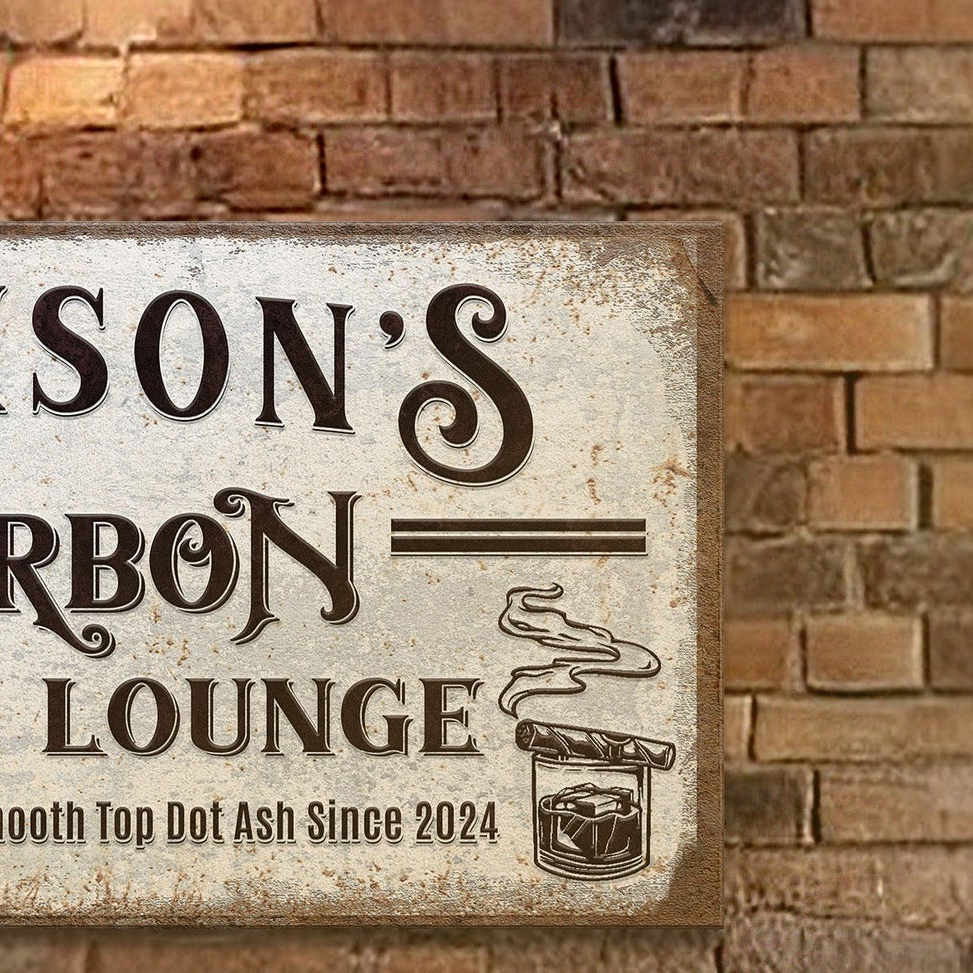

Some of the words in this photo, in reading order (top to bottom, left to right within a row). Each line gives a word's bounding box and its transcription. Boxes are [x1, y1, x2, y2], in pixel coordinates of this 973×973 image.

[41, 678, 482, 756] LOUNGE
[96, 801, 155, 847] Top
[167, 801, 224, 842] Dot
[233, 801, 295, 842] Ash
[307, 801, 403, 842] Since
[415, 801, 499, 842] 2024
